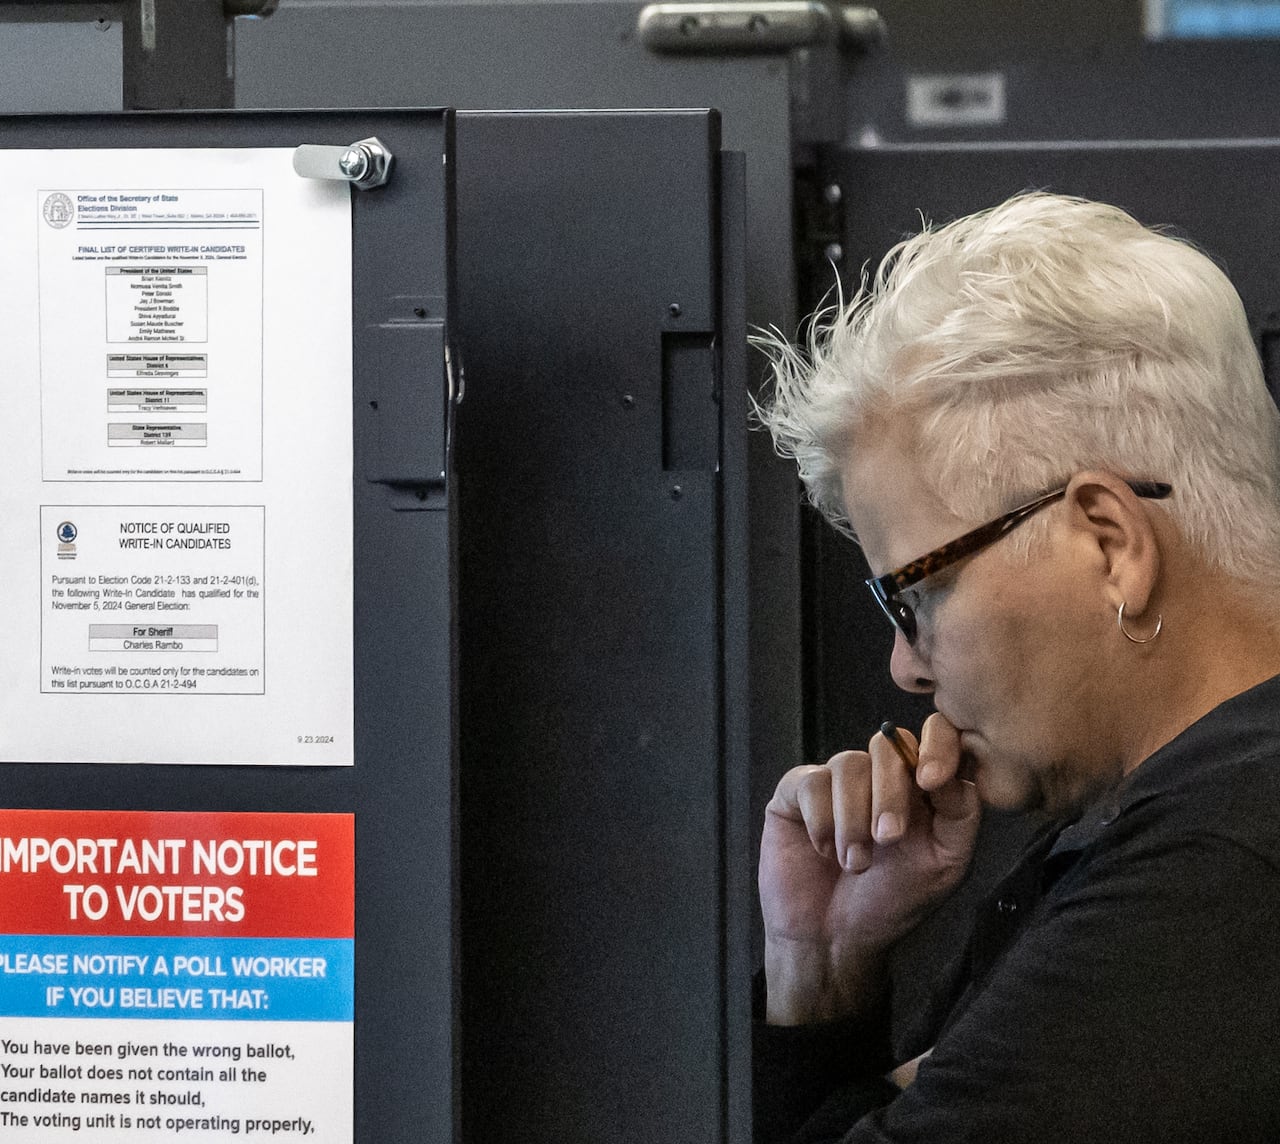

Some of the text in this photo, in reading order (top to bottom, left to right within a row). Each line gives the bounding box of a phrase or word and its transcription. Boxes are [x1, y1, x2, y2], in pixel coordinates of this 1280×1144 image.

[120, 195, 151, 203] Secretary
[161, 194, 178, 202] State
[110, 204, 137, 212] Division
[120, 522, 230, 534] NOTICE OF QUALIFIED
[118, 538, 231, 550] WRITE-IN CANDIDATES
[52, 575, 86, 584] Pursuant
[88, 576, 97, 584] to
[98, 575, 129, 584] Election
[130, 575, 152, 585] Code
[154, 575, 191, 585] 21-2-133
[192, 576, 208, 585] and
[51, 588, 65, 598] the
[67, 588, 100, 600] following
[135, 588, 176, 598] Candidate
[181, 589, 196, 598] has
[198, 588, 231, 600] qualified
[233, 588, 244, 598] for
[246, 589, 260, 598] the
[52, 601, 92, 610] November
[93, 601, 100, 611] 5,
[102, 601, 122, 610] 2024
[124, 600, 156, 610] General
[133, 627, 174, 638] For Sheriff
[123, 640, 184, 651] Charles Rambo
[51, 666, 81, 676] Write-in
[82, 666, 104, 676] votes
[104, 666, 117, 675] will
[118, 666, 128, 676] be
[129, 666, 162, 676] counted
[162, 667, 179, 678] only
[180, 666, 191, 676] for
[192, 667, 206, 676] the
[206, 667, 248, 676] candidates
[51, 679, 65, 688] this
[66, 679, 78, 688] list
[79, 680, 114, 690] pursuant
[115, 680, 124, 688] to
[160, 679, 197, 689] 21-2-494
[193, 839, 318, 876] NOTICE
[63, 884, 245, 922] TO VOTERS
[73, 954, 148, 975] NOTIFY
[153, 956, 169, 976] A
[174, 956, 227, 976] POLL
[232, 956, 327, 978] WORKER
[46, 986, 268, 1009] IF YOU BELIEVE THAT:
[1, 1039, 295, 1061] You have been given the wrong ballot,
[0, 1063, 267, 1082] Your ballot does not contain all the
[0, 1088, 205, 1108] candidate names it should,
[0, 1112, 315, 1135] The voting unit is not operating properly,
